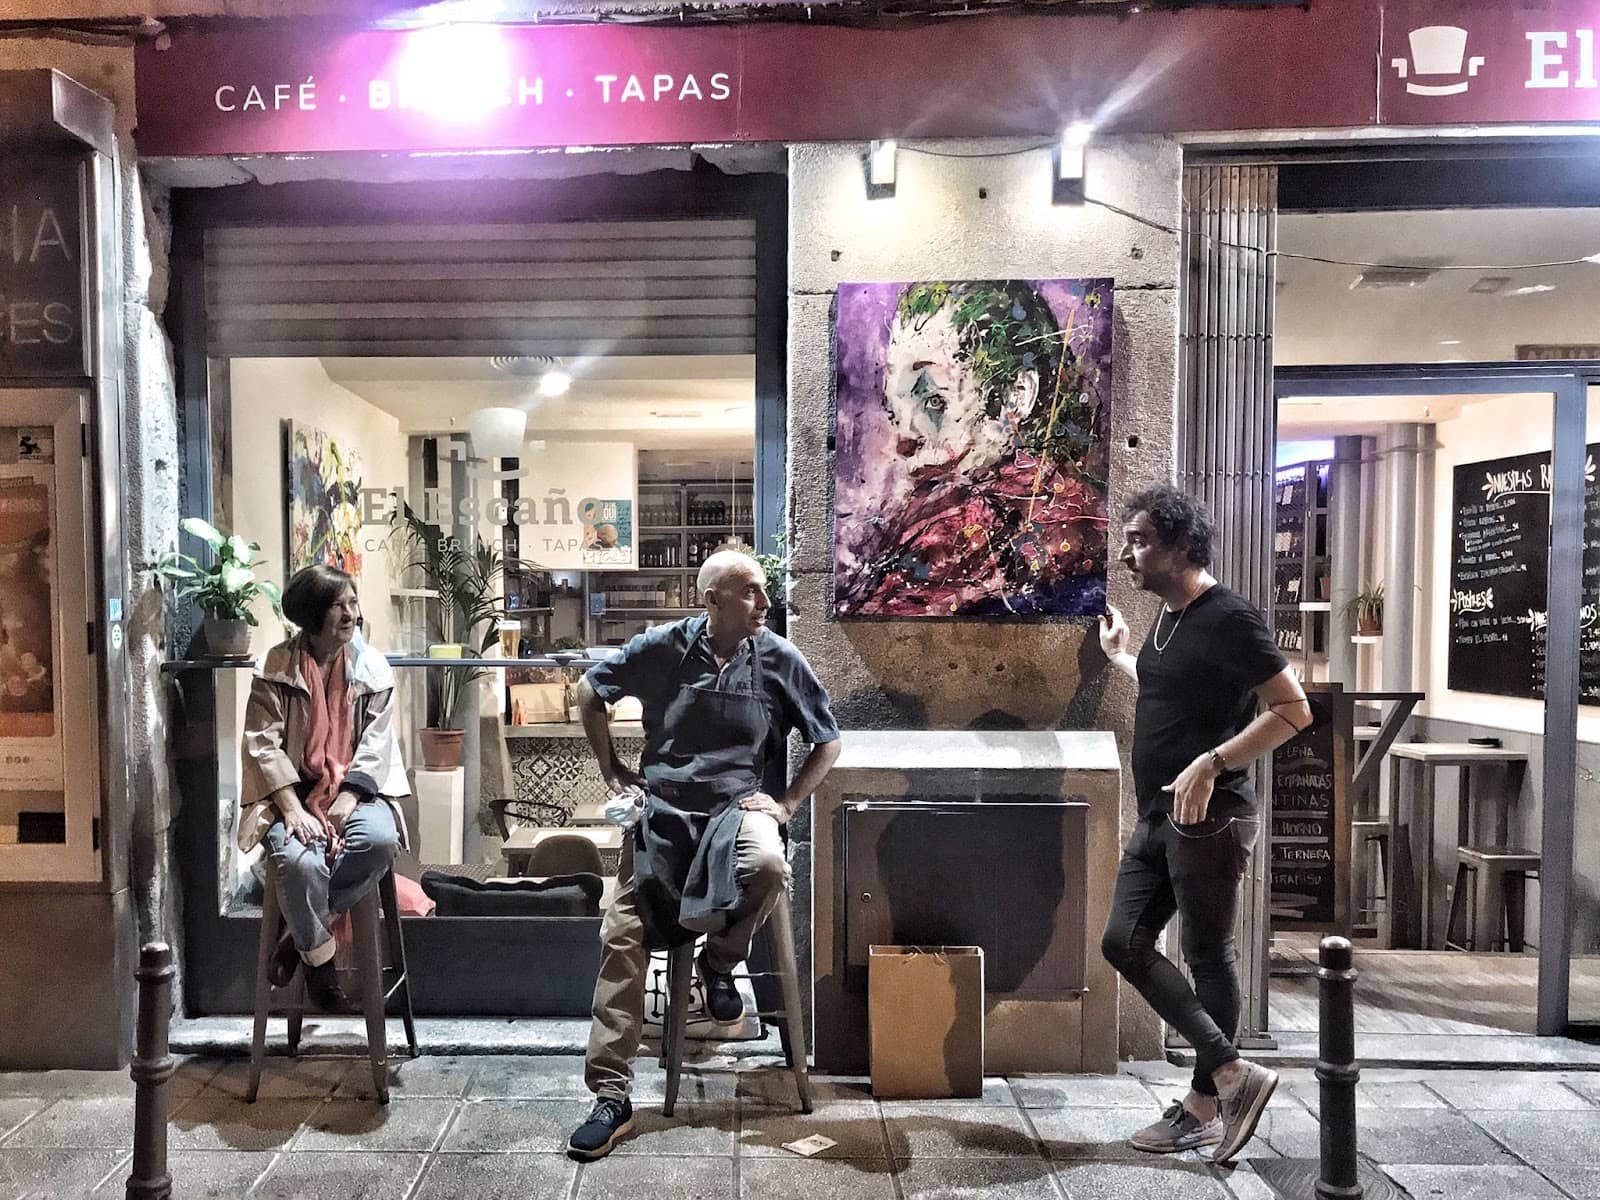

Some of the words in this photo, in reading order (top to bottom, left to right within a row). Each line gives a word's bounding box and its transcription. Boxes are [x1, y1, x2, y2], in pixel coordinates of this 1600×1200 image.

[1525, 29, 1598, 88] El
[214, 76, 317, 111] CAFÉ
[594, 73, 731, 103] TAPAS
[0, 302, 73, 344] ES
[360, 487, 412, 526] El
[423, 487, 600, 526] Escaño
[543, 538, 603, 553] TAPAS
